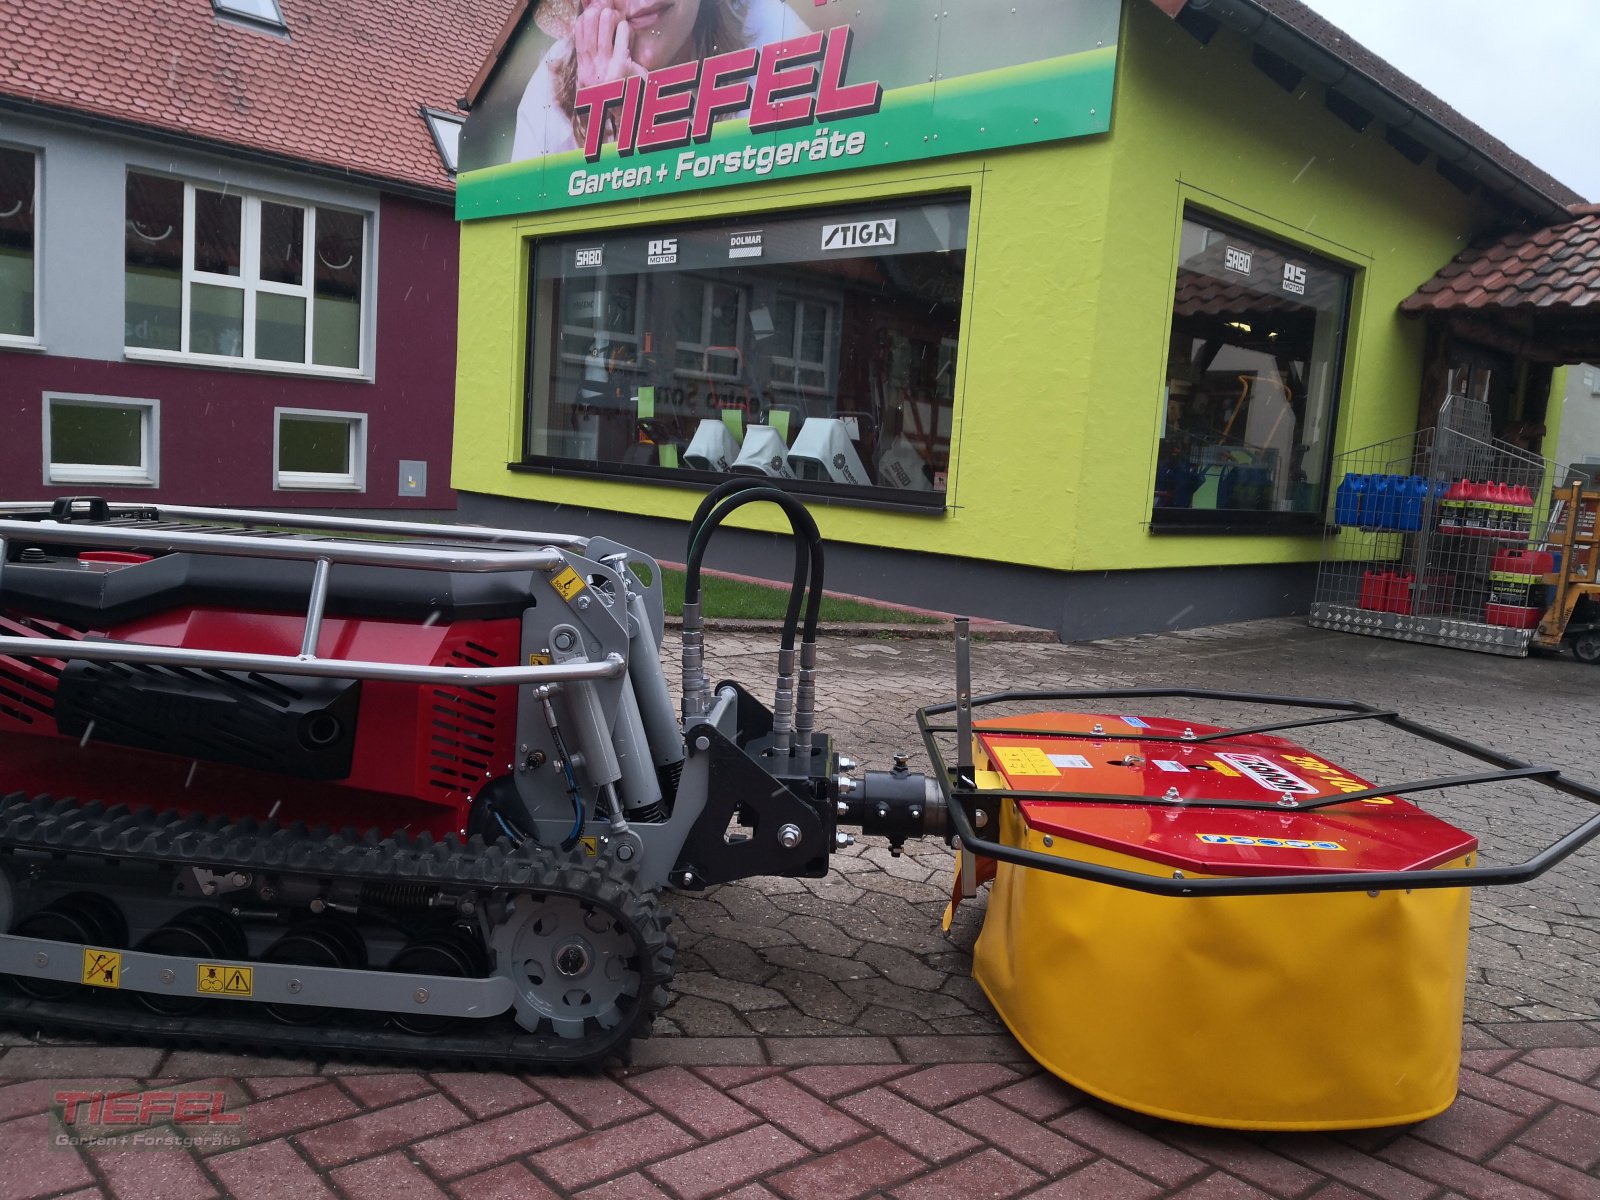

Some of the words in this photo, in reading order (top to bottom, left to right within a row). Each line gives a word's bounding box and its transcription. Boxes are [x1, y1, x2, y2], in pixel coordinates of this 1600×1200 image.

[574, 24, 883, 163] TIEFEL
[567, 163, 651, 196] Garten
[656, 163, 669, 183] +
[674, 127, 867, 181] Forstgeräte
[730, 235, 762, 246] DOLMAR
[824, 222, 892, 248] STIGA
[648, 239, 678, 255] AS
[576, 249, 601, 266] SABO
[649, 255, 676, 264] MOTOR
[1225, 248, 1251, 273] SABO
[1283, 262, 1307, 285] AS
[1283, 280, 1304, 294] MOTOR
